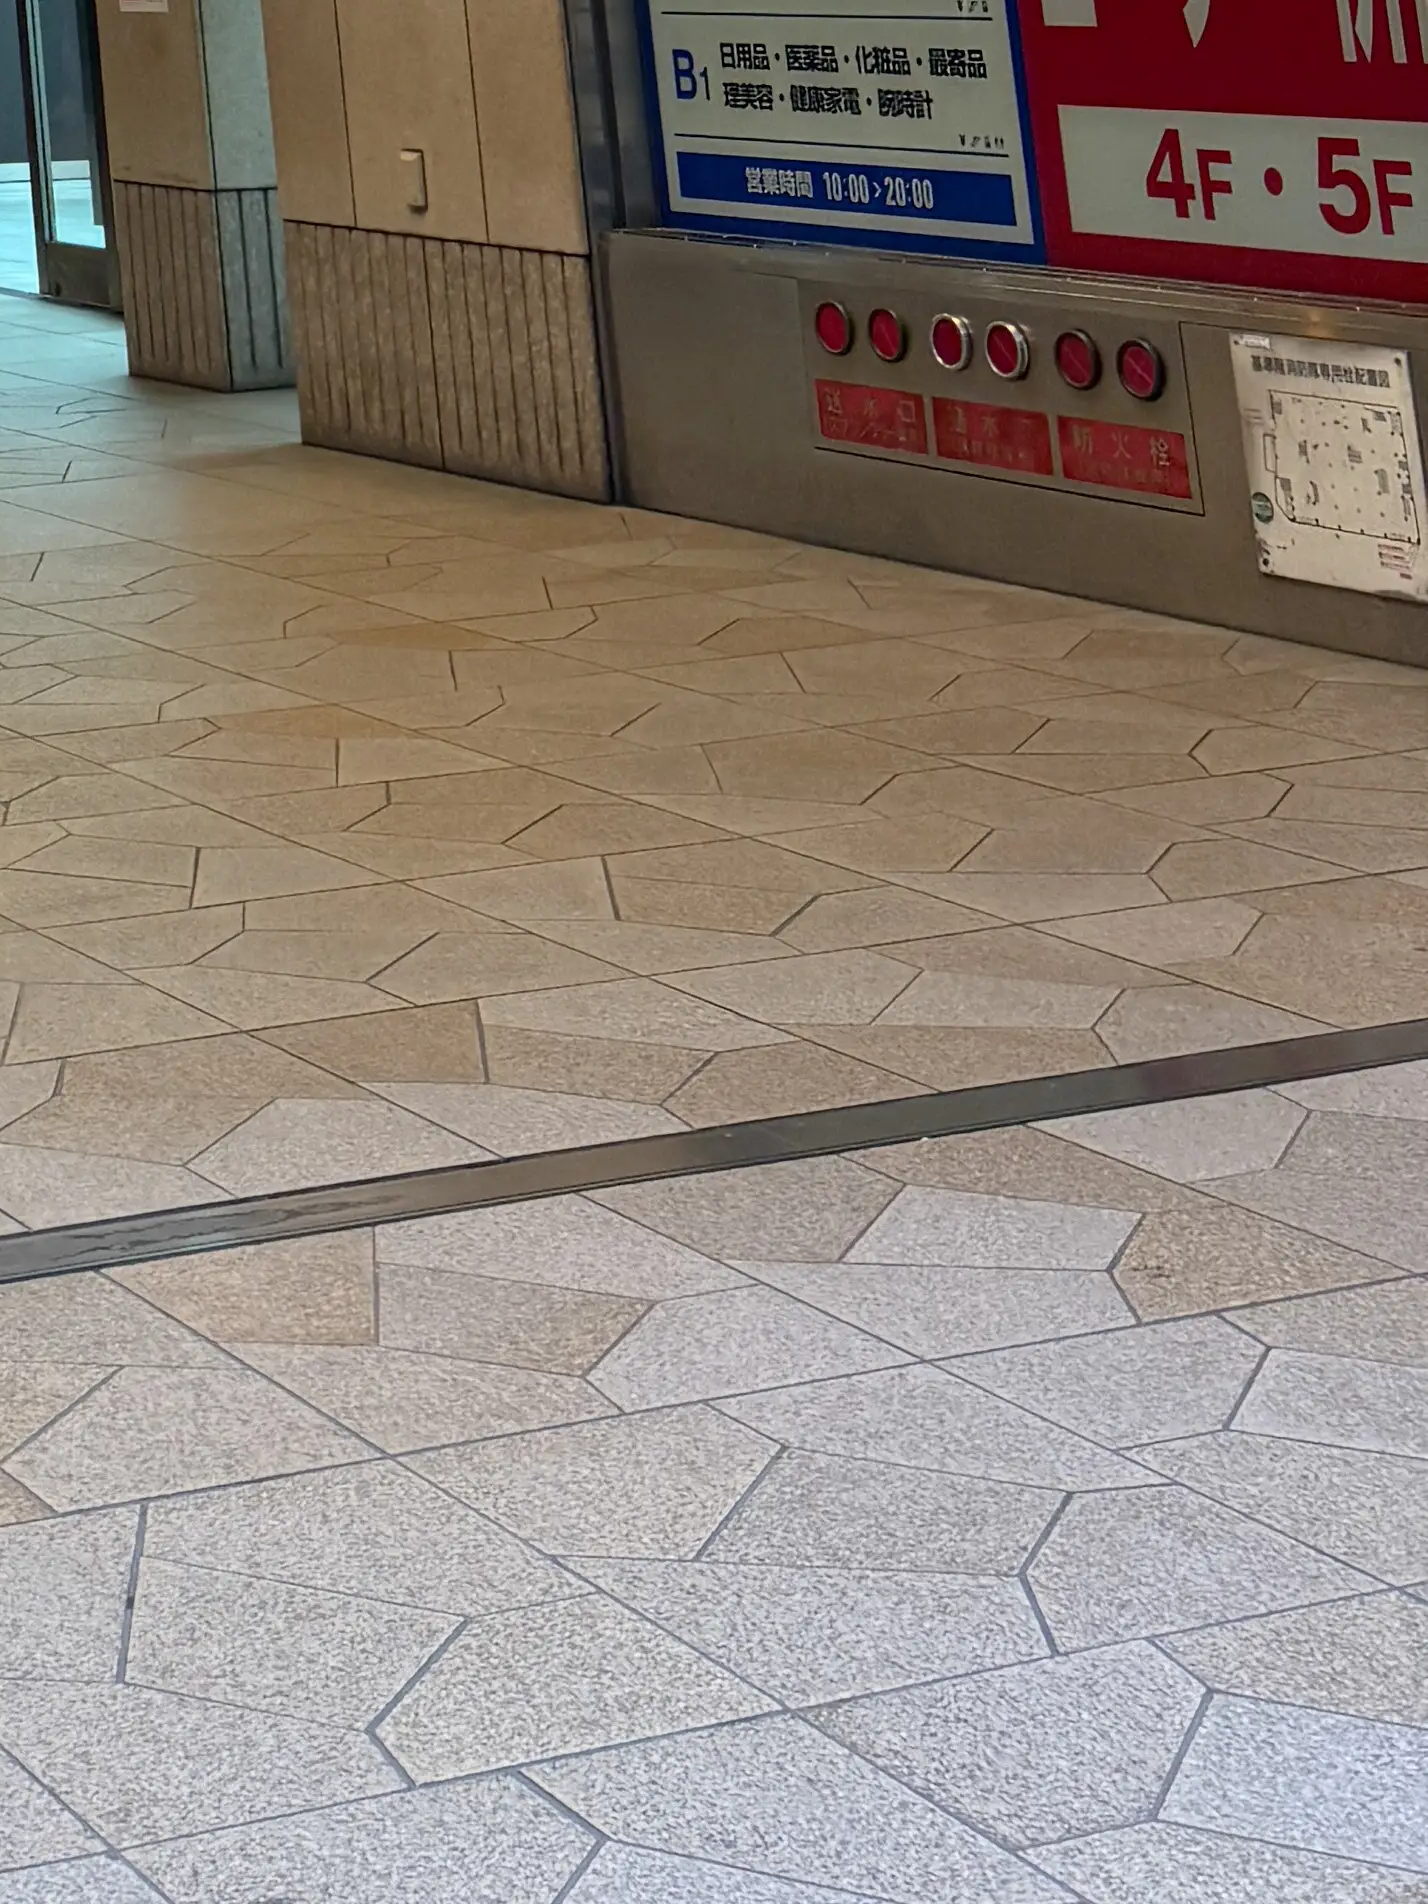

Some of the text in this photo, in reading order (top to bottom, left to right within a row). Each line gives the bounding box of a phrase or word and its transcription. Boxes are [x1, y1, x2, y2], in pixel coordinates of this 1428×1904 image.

[672, 48, 711, 101] B1
[719, 42, 988, 80] 日用品・医薬品・化粧品・最寄品
[745, 167, 813, 199] 営業時間
